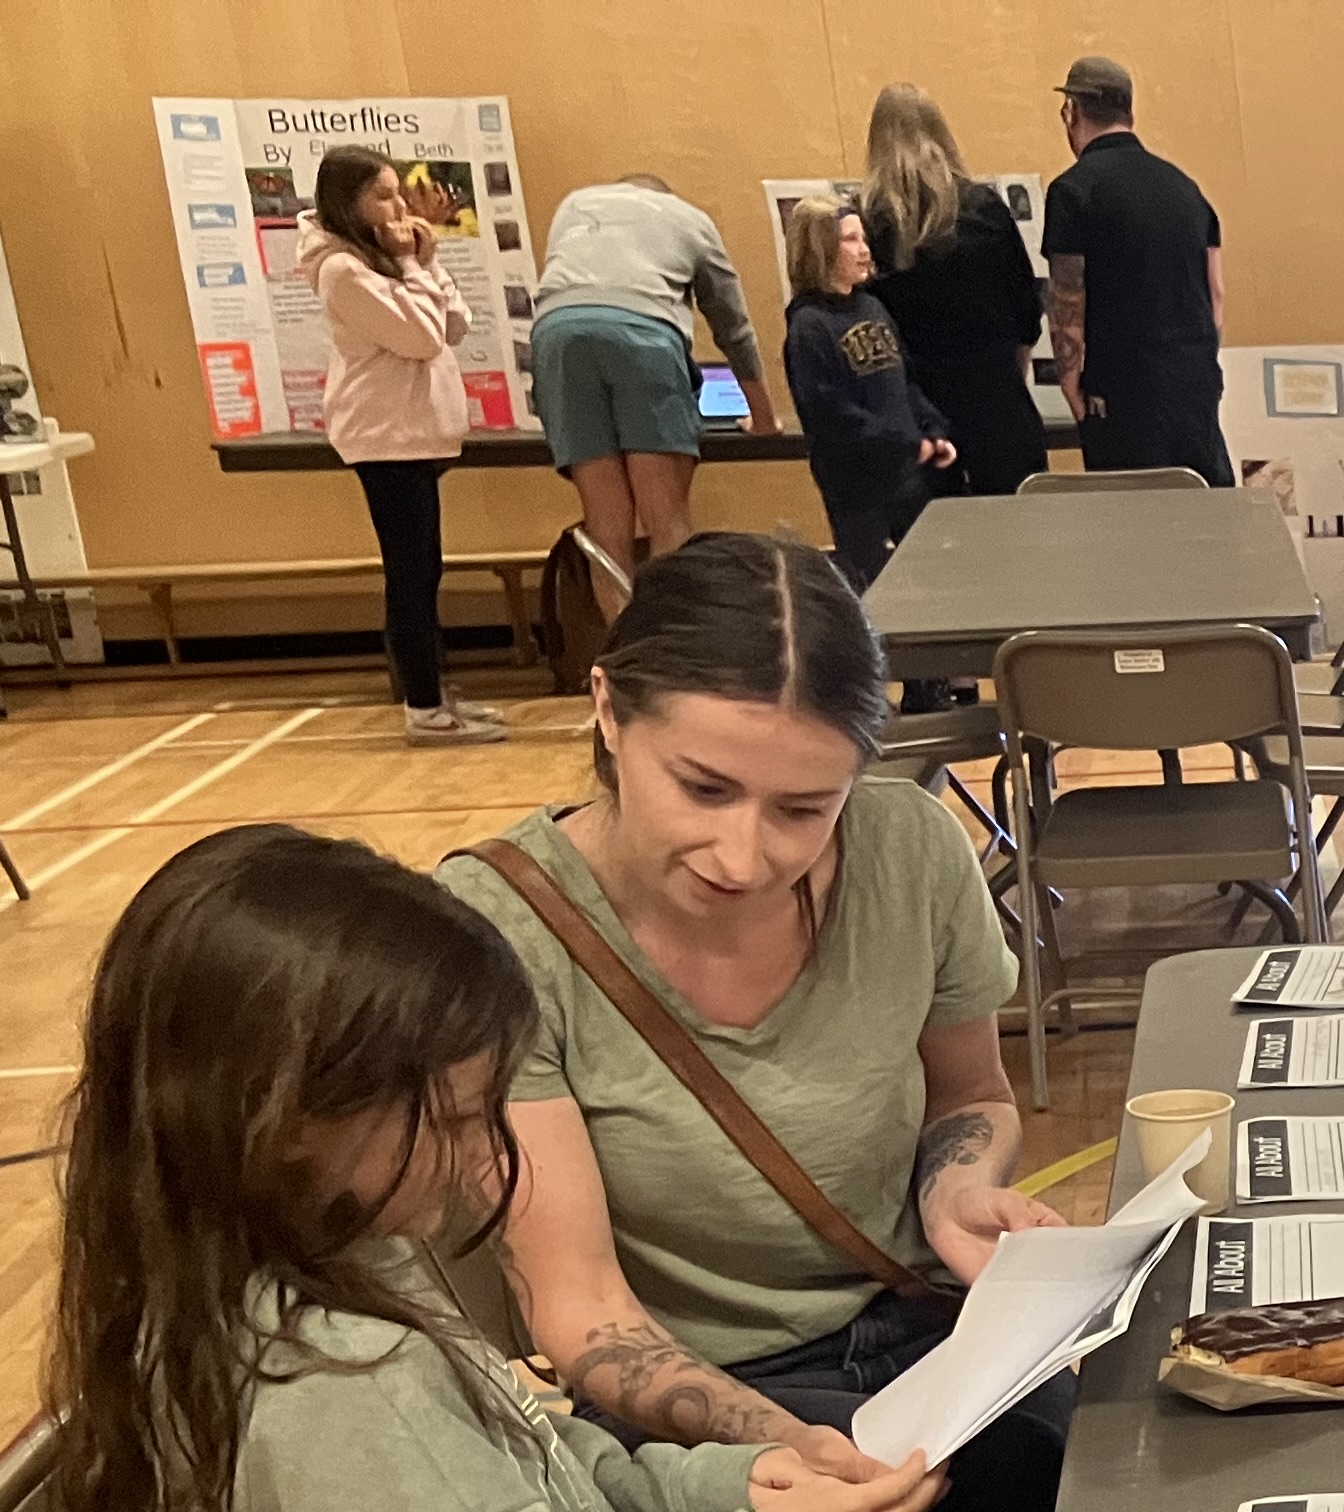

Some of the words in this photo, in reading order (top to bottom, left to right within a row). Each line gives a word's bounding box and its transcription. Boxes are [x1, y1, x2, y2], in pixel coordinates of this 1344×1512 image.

[268, 107, 420, 134] Butterflies
[263, 143, 292, 166] By
[1254, 1137, 1282, 1165] About
[1255, 1165, 1283, 1177] All
[1213, 1240, 1246, 1276] About
[1213, 1278, 1244, 1293] All
